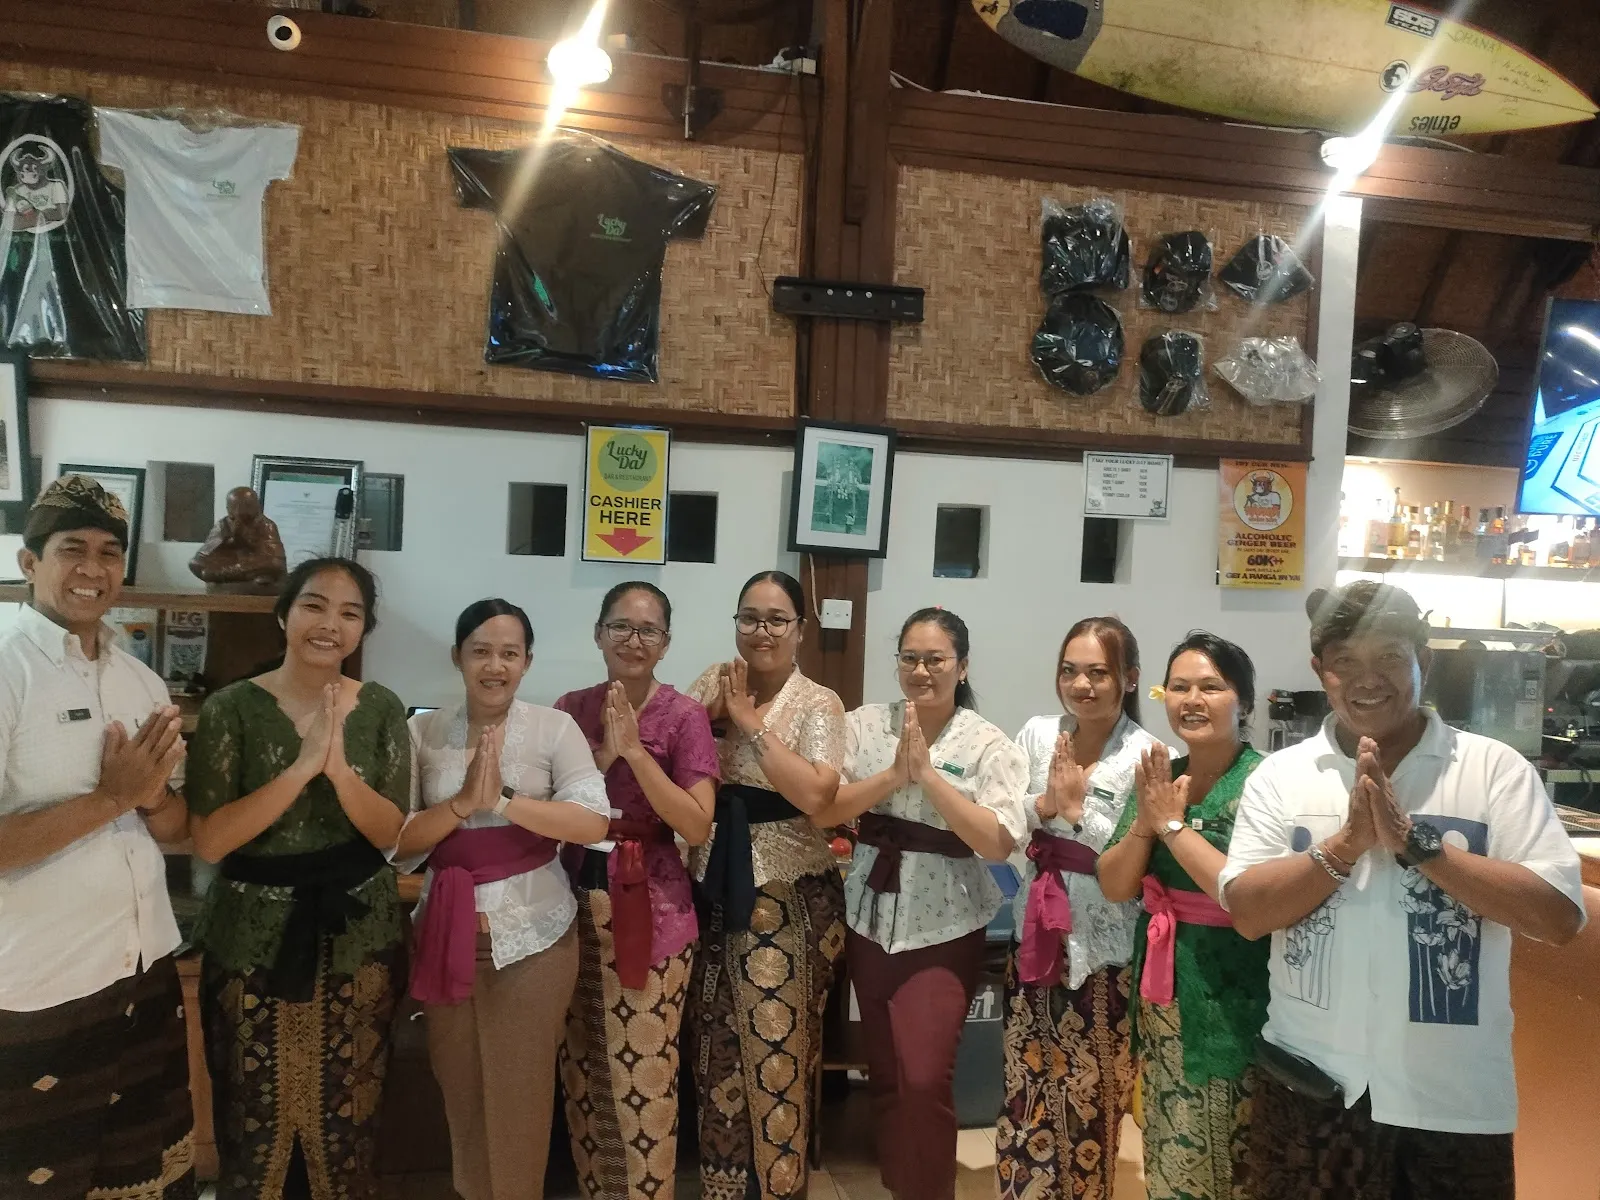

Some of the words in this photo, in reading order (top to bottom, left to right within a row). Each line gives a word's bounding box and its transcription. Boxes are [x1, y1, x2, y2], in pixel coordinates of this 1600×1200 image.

[1408, 115, 1461, 133] etnies
[607, 440, 648, 463] Lucky
[590, 495, 662, 510] CASHIER
[600, 510, 651, 526] HERE
[1235, 532, 1292, 541] ALCOHOLIC
